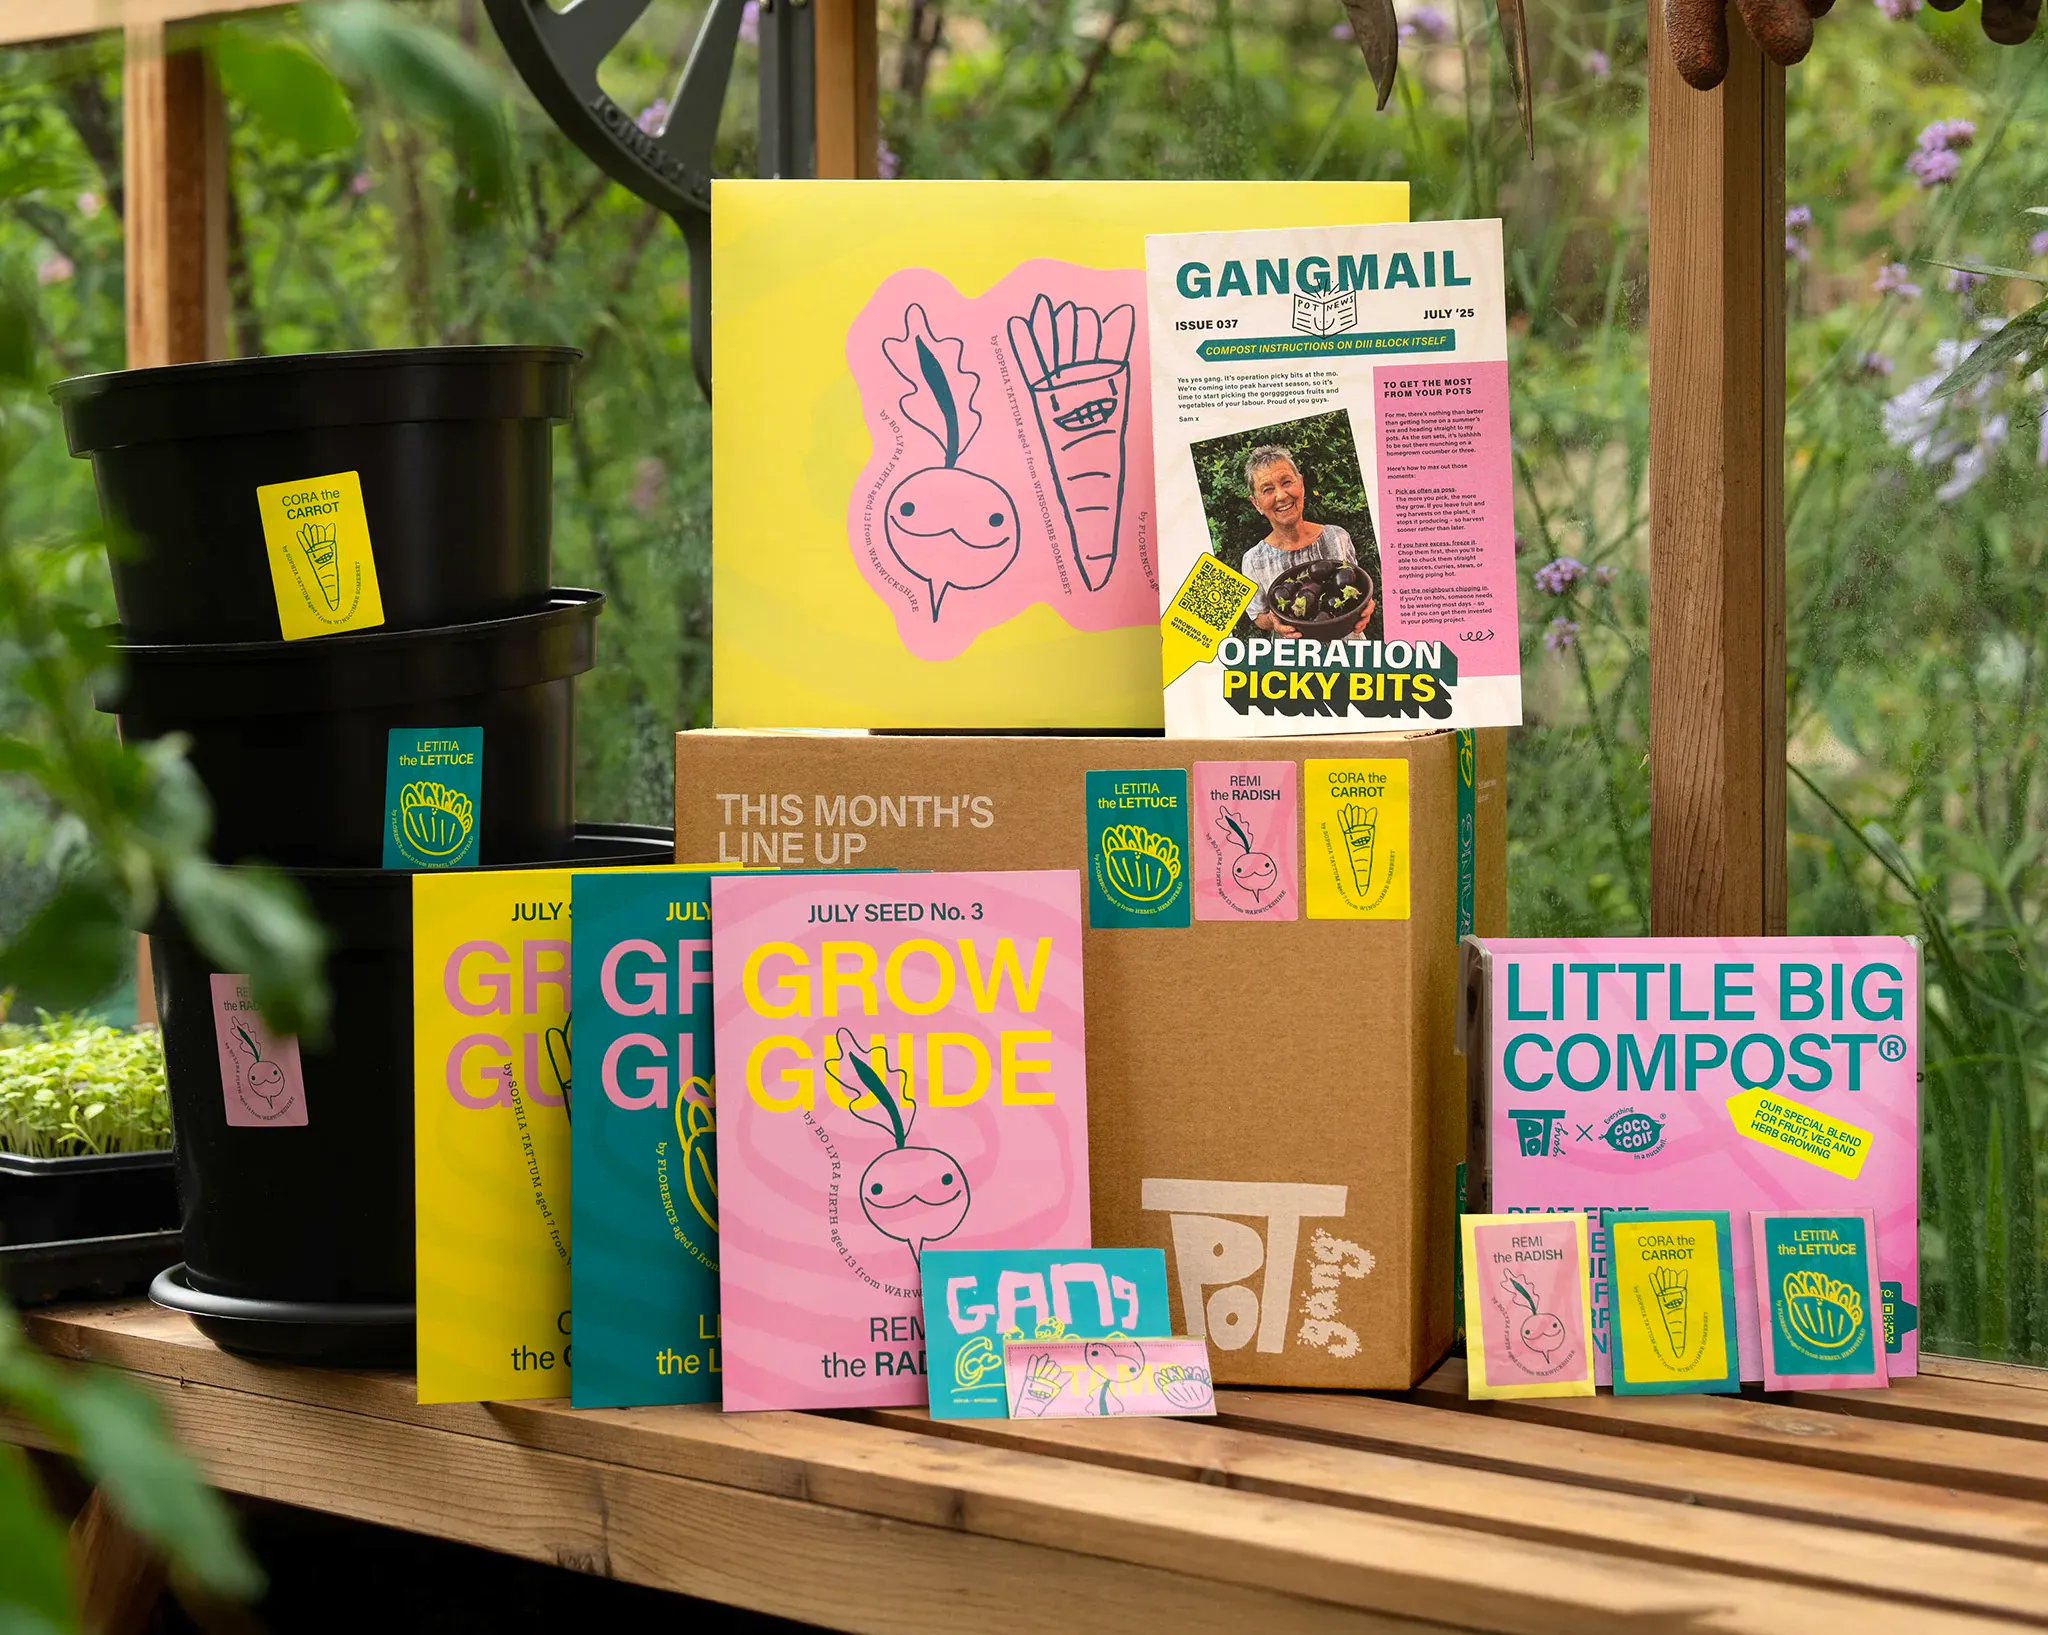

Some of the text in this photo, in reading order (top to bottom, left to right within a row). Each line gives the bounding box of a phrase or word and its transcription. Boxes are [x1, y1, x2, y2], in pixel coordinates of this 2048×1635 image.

[1176, 250, 1471, 299] GANGMAIL
[1297, 295, 1354, 311] POT NEWS
[1423, 308, 1474, 319] JULY '25
[1175, 319, 1238, 331] ISSUE 037
[1205, 344, 1256, 355] COMPOST
[1259, 341, 1334, 352] INSTRUCTIONS
[1336, 340, 1352, 350] ON
[1375, 337, 1409, 348] BLOCK
[1411, 335, 1446, 346] ITSELF
[1270, 372, 1288, 380] picky
[1383, 377, 1472, 389] TO GET THE MOST
[1220, 391, 1246, 399] picking
[1239, 382, 1256, 390] peak
[1384, 387, 1471, 398] FROM YOUR POTS
[990, 334, 998, 346] by
[994, 347, 1011, 385] SOPHIA
[1006, 385, 1023, 426] TATTUM
[1017, 428, 1030, 449] aged
[1026, 456, 1037, 479] from
[1034, 480, 1056, 541] WINSCOMBE
[1051, 542, 1072, 595] SOMERSET
[281, 489, 340, 507] CORA the
[286, 501, 339, 520] CARROT
[863, 409, 919, 612] by BO LYRA FIRTH aged 13 from WARWICKSHIRE
[1138, 512, 1153, 577] by FLORENCE
[1171, 620, 1210, 648] WHATSAPP US
[1217, 638, 1442, 669] OPERATION
[1224, 670, 1436, 702] PICKY BITS
[416, 740, 459, 752] LETITIA
[399, 753, 473, 766] the LETTUCE
[1230, 775, 1261, 786] REMI
[1328, 772, 1387, 784] CORA the
[1114, 782, 1160, 795] LETITIA
[1210, 789, 1280, 800] the RADISH
[1330, 786, 1384, 797] CARROT
[716, 793, 993, 828] THIS MONTH'S
[1097, 796, 1177, 809] the LETTUCE
[719, 831, 866, 864] LINE UP
[511, 902, 563, 921] JULY
[808, 902, 983, 923] JULY SEED No. 3
[443, 940, 571, 1016] GR
[742, 937, 1053, 1019] GROW
[1507, 963, 1904, 1021] LITTLE BIG
[745, 1030, 1055, 1113] GUIDE
[1604, 1107, 1634, 1125] Everything
[1759, 1099, 1861, 1147] OUR SPECIAL BLEND
[1750, 1120, 1830, 1159] HERB GROWING
[1754, 1109, 1856, 1157] FOR FRUIT, VEG AND
[656, 1142, 667, 1156] by
[503, 1062, 513, 1077] by
[508, 1080, 527, 1130] SOPHIA
[521, 1133, 542, 1188] TATTUM
[535, 1191, 552, 1218] aged
[550, 1229, 567, 1258] from
[657, 1159, 678, 1224] FLORENCE
[803, 1110, 880, 1289] by BO LYRA FIRTH aged 13 from
[673, 1225, 693, 1249] aged
[1511, 1235, 1543, 1248] REMI
[1637, 1235, 1695, 1247] CORA the
[1793, 1229, 1839, 1241] LETITIA
[690, 1246, 698, 1255] 9
[1493, 1249, 1563, 1263] the RADISH
[1641, 1248, 1693, 1261] CARROT
[1777, 1243, 1856, 1255] the LETTUCE
[511, 1346, 555, 1370] the
[656, 1348, 700, 1374] the
[821, 1352, 866, 1378] the
